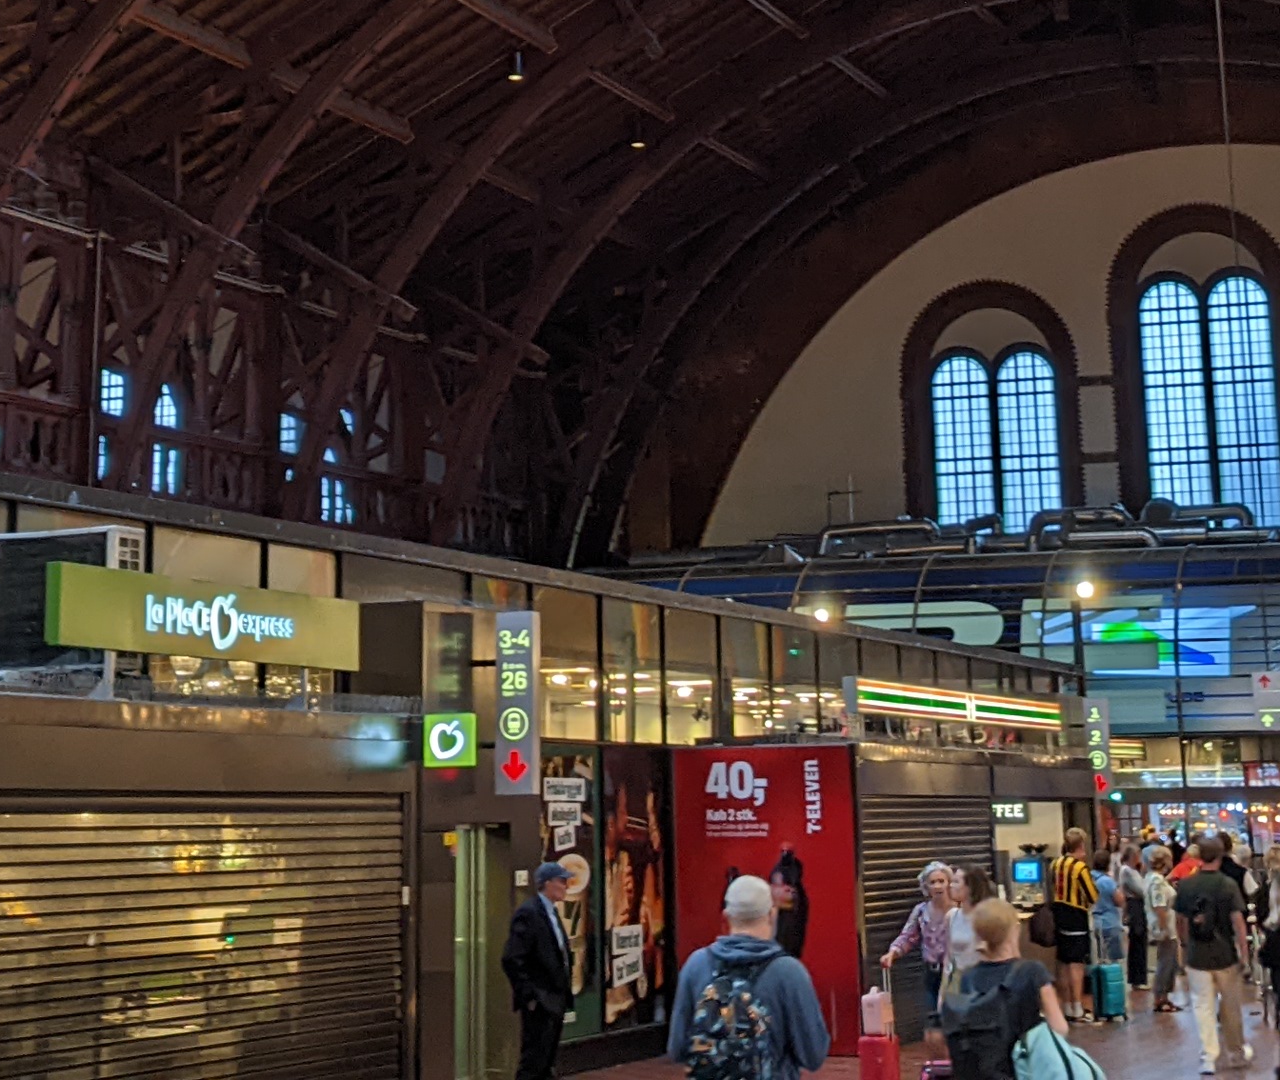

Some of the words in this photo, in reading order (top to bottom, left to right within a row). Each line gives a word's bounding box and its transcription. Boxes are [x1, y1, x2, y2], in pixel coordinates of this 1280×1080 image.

[238, 613, 294, 642] express
[499, 629, 530, 648] 3-4
[501, 671, 528, 690] 26
[1090, 707, 1100, 718] 1
[1091, 730, 1102, 741] 2
